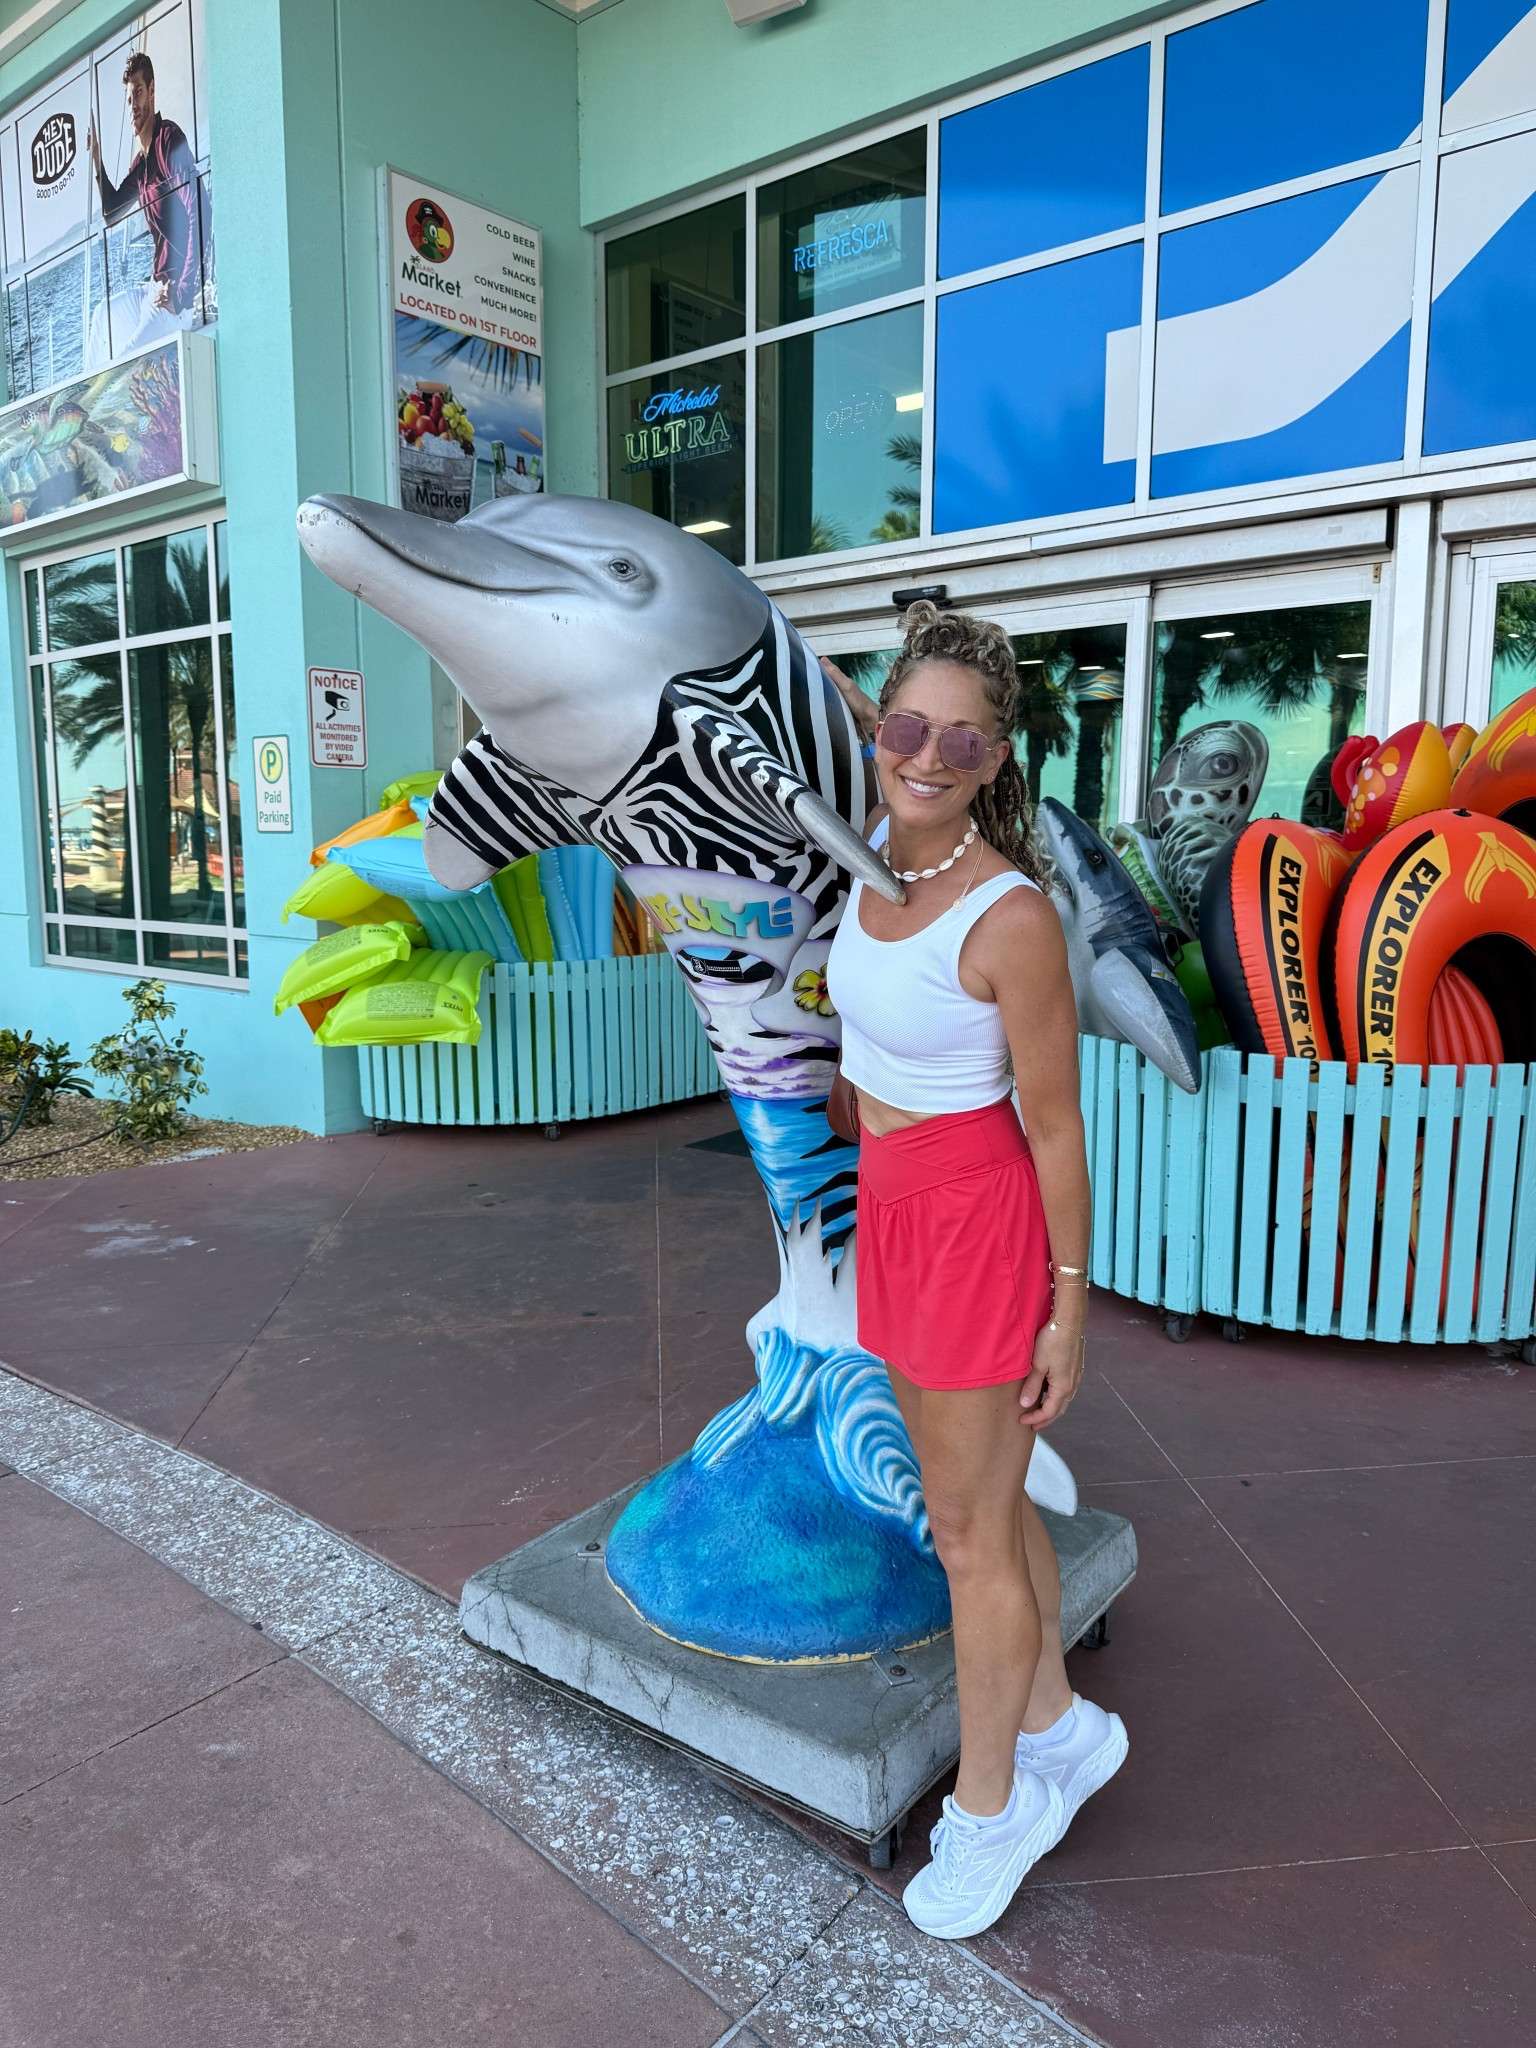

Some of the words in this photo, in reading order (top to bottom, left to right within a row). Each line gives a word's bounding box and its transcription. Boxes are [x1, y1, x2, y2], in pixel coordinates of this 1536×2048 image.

[42, 117, 64, 145] HEY
[33, 123, 73, 178] DUDE
[36, 188, 51, 199] GOOD
[51, 185, 58, 196] TO
[59, 167, 75, 191] GO-TO
[486, 223, 511, 240] COLD
[513, 234, 536, 250] BEER
[793, 219, 888, 272] REFRESCA
[512, 252, 536, 268] WINE
[401, 261, 462, 298] Market
[502, 266, 537, 286] SNACKS
[474, 275, 537, 305] CONVENIENCE
[400, 292, 457, 321] LOCATED
[459, 312, 477, 328] ON
[479, 319, 498, 335] 1ST
[500, 326, 537, 348] FLOOR
[480, 295, 507, 312] MUCH
[509, 307, 537, 323] MORE!
[643, 384, 721, 422] Michelob
[625, 411, 731, 463] ULTRA
[673, 449, 700, 462] LIGHT
[704, 443, 729, 454] BEER
[416, 485, 468, 508] Market
[314, 675, 358, 691] NOTICE
[315, 722, 327, 730] ALL
[328, 723, 361, 733] ACTIVITIES
[320, 732, 358, 742] MONITORED
[325, 742, 334, 750] BY
[334, 743, 354, 752] VIDEO
[326, 753, 354, 762] CAMERA
[266, 749, 277, 777] P
[264, 790, 282, 804] Paid
[259, 810, 290, 826] Parking
